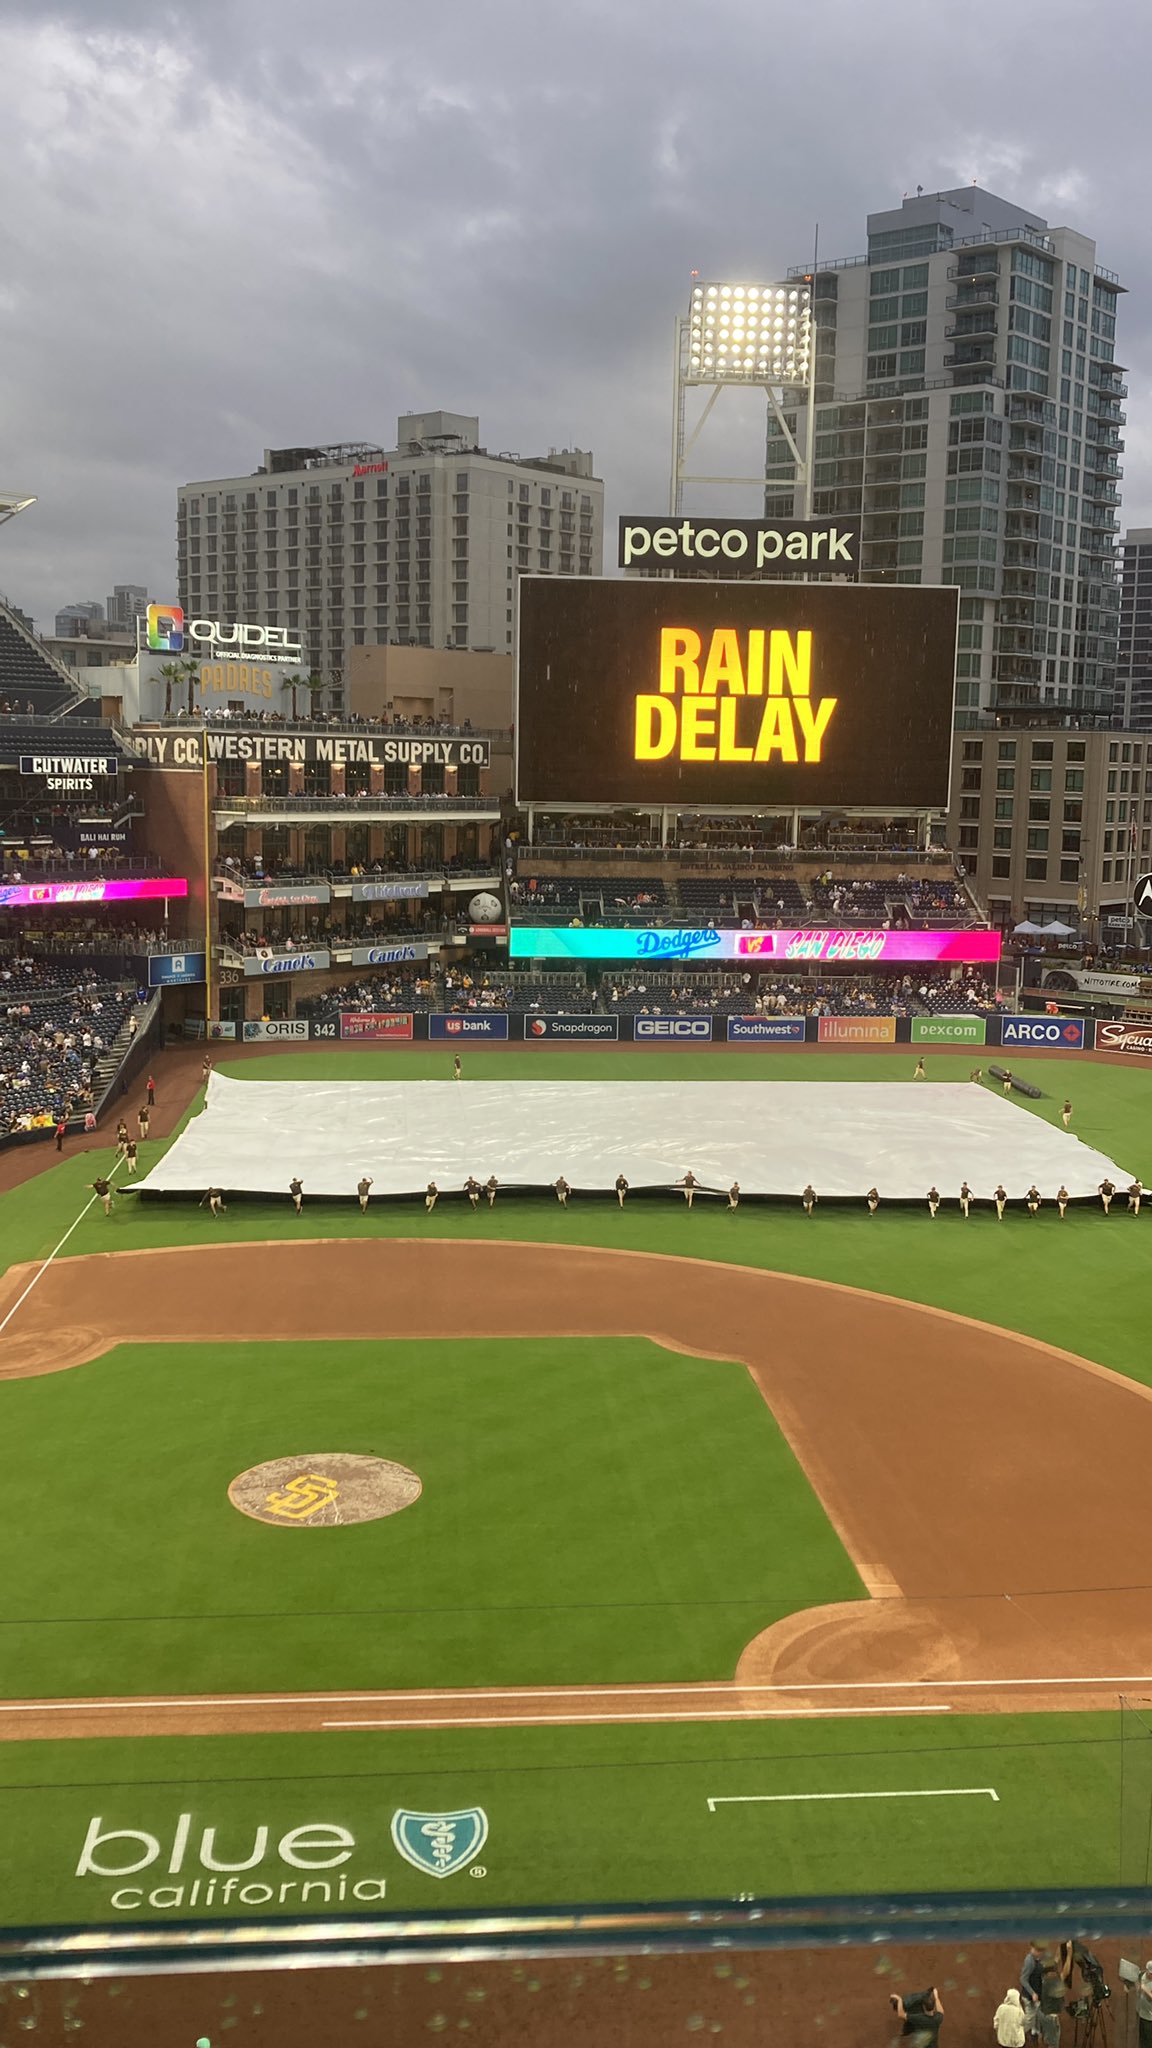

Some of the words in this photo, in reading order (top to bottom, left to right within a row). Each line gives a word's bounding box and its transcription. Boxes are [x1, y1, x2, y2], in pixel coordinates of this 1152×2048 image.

[624, 521, 748, 565] petco
[756, 528, 854, 568] park
[189, 620, 301, 648] QUIDEL
[216, 651, 241, 659] OFFICIAL
[241, 653, 277, 662] DIAGNOSTICS
[277, 656, 302, 664] PARTNER
[660, 627, 812, 695] RAIN
[201, 662, 273, 699] PADRES
[635, 694, 837, 762] DELAY
[174, 737, 203, 765] CO.
[207, 735, 305, 760] WESTERN
[316, 739, 379, 762] METAL
[384, 741, 453, 764] SUPPLY
[460, 743, 488, 764] CO.
[32, 758, 108, 774] CUTWATER
[47, 778, 93, 790] SPIRITS
[636, 929, 721, 957] Dodgers
[748, 936, 763, 953] VS
[785, 931, 826, 958] SAN
[826, 931, 886, 959] DIEGO
[261, 954, 316, 973] Canel's
[367, 946, 416, 964] Canel's
[220, 971, 239, 984] 336
[1084, 977, 1137, 988] NITTOTIRE.COM
[266, 1023, 305, 1035] ORIS
[314, 1024, 336, 1037] 342
[447, 1022, 461, 1031] us
[463, 1020, 491, 1031] bank
[552, 1022, 612, 1034] Snapdragon
[637, 1021, 709, 1035] GEICO
[733, 1024, 793, 1035] Southwest
[824, 1022, 889, 1038] illumina
[1004, 1024, 1061, 1040] ARCO
[1101, 1025, 1152, 1050] Sycua
[75, 1813, 356, 1876] blue
[111, 1875, 387, 1910] california
